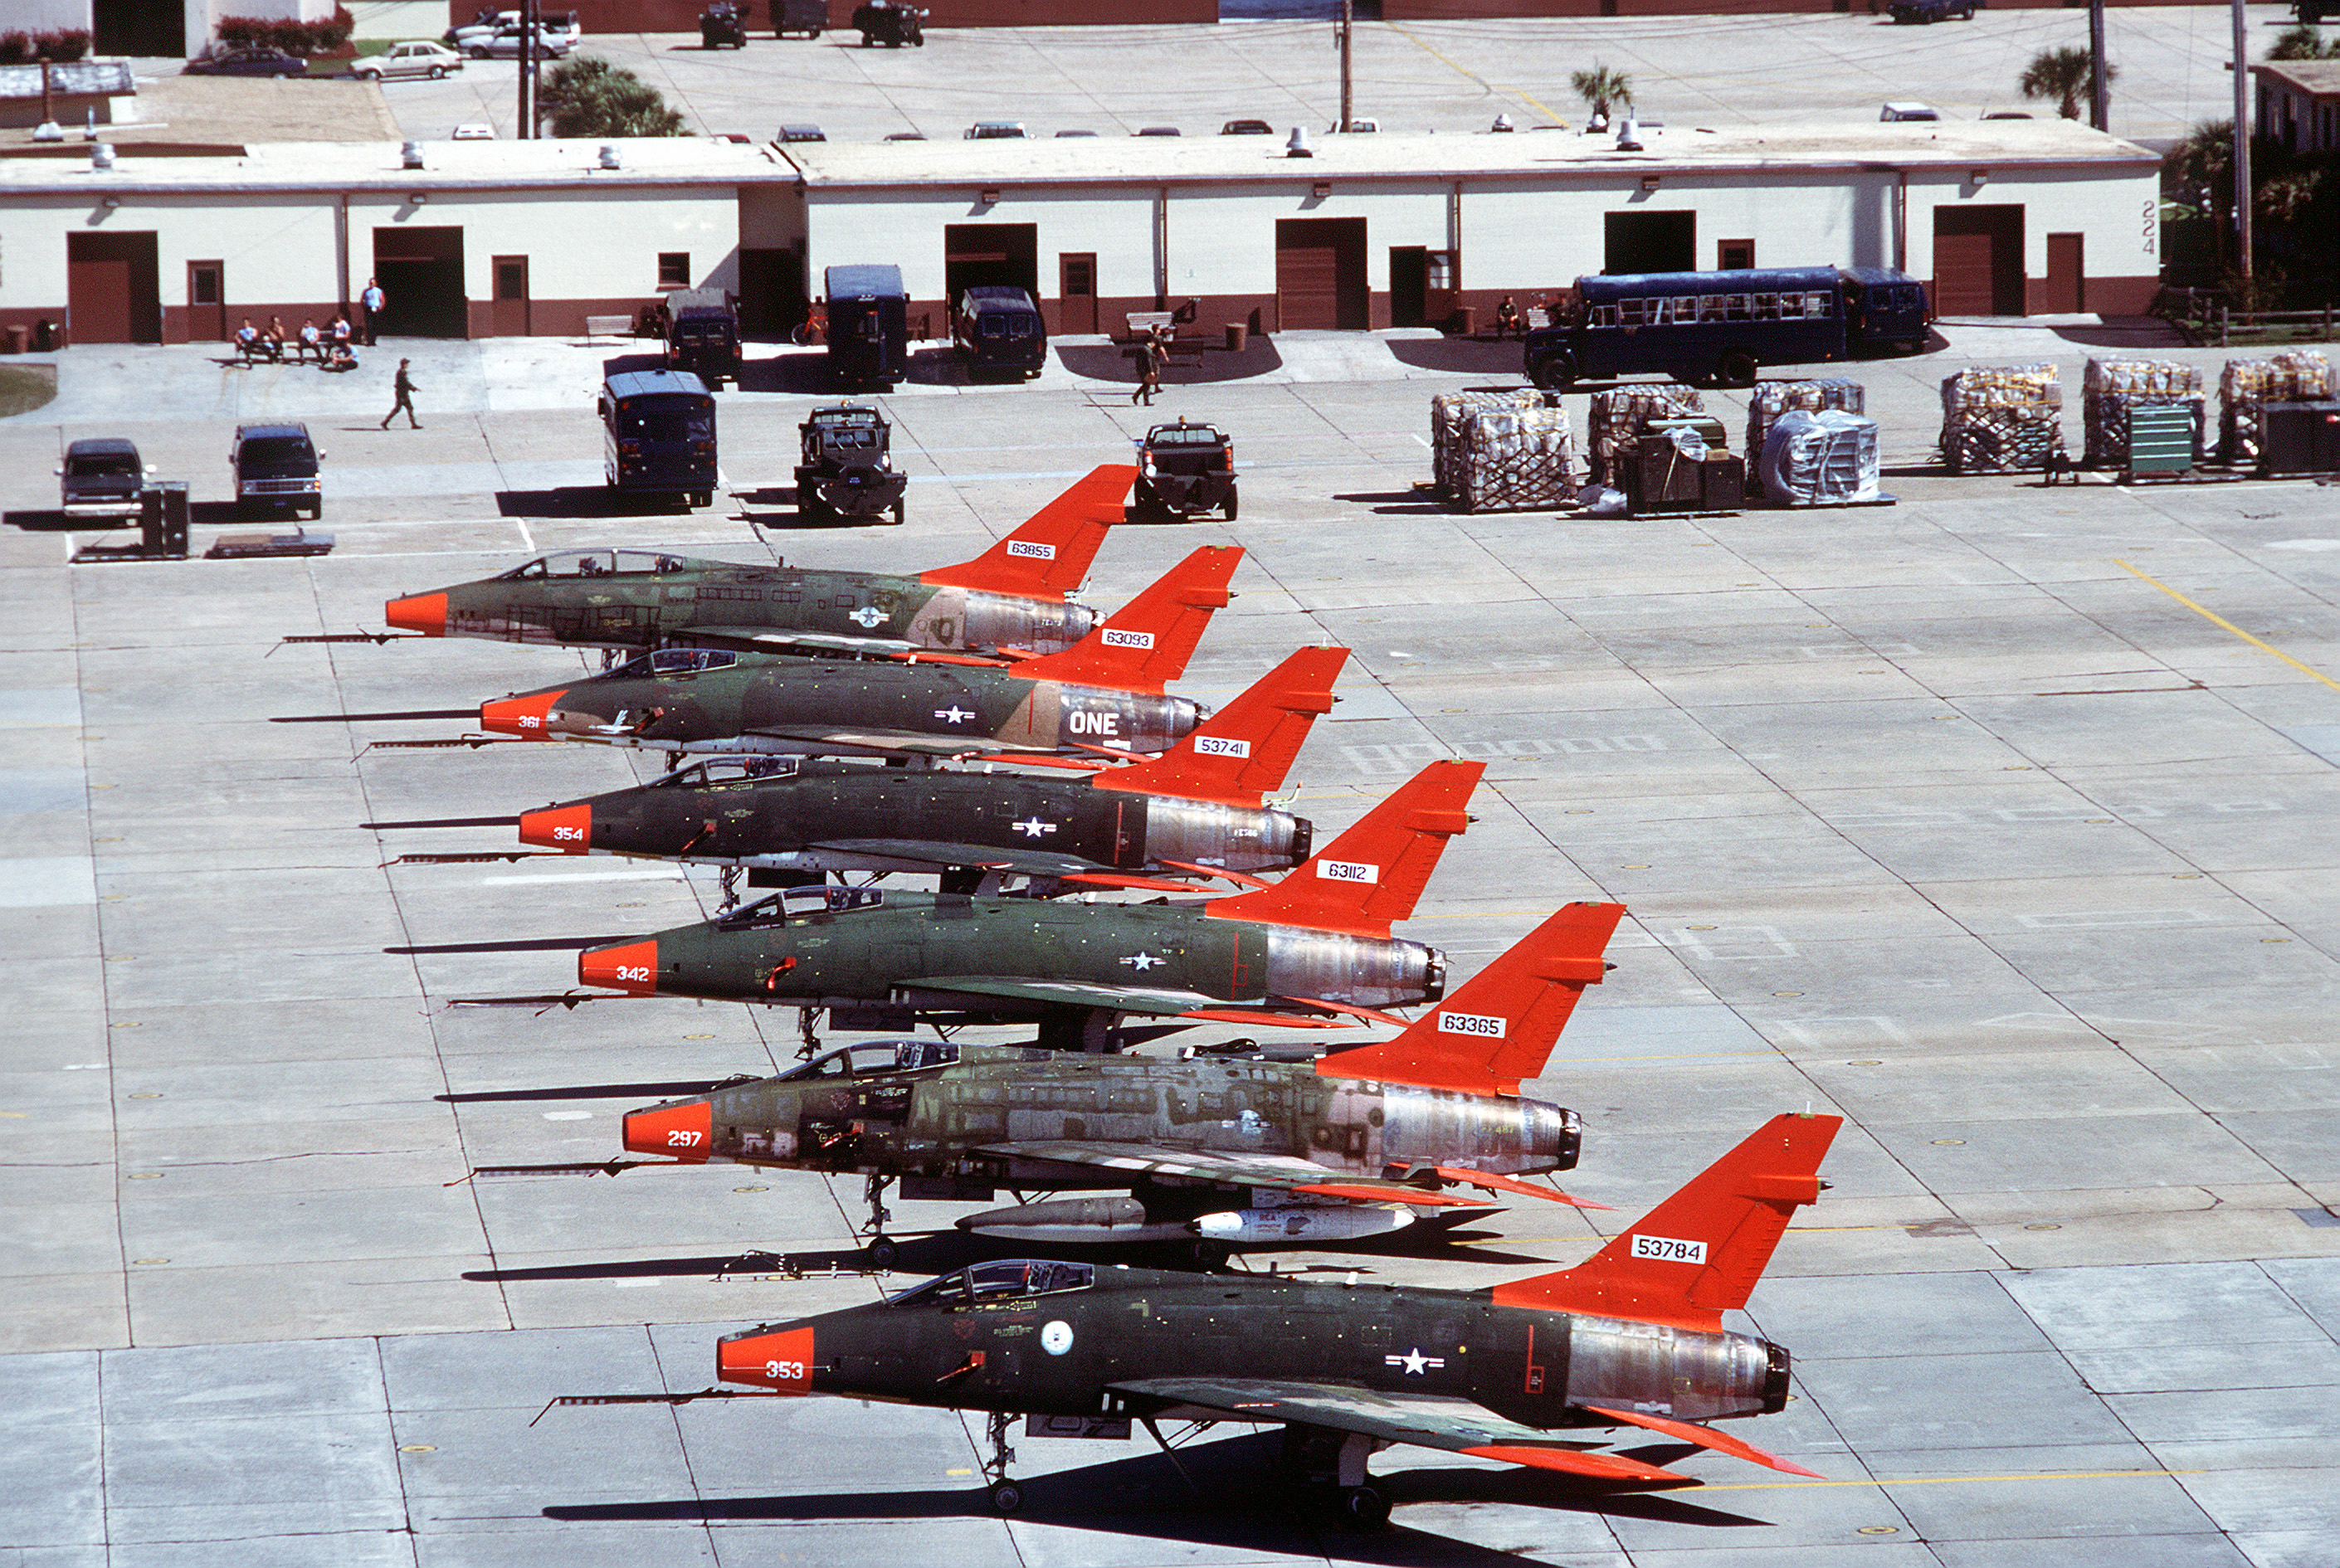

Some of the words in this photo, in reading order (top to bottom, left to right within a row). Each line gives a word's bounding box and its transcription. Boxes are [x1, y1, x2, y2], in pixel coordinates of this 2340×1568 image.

[2143, 200, 2155, 255] 224
[1012, 543, 1051, 558] 63855
[1106, 631, 1149, 646] 63093
[518, 715, 539, 728] 361
[1070, 711, 1119, 736] ONE
[1202, 738, 1243, 755] 53741
[553, 826, 583, 840] 354
[1328, 863, 1367, 880] 63112
[617, 966, 649, 981] 342
[1445, 1015, 1499, 1035] 63365
[667, 1130, 703, 1147] 297
[1638, 1239, 1700, 1260] 53784
[766, 1360, 803, 1379] 353
